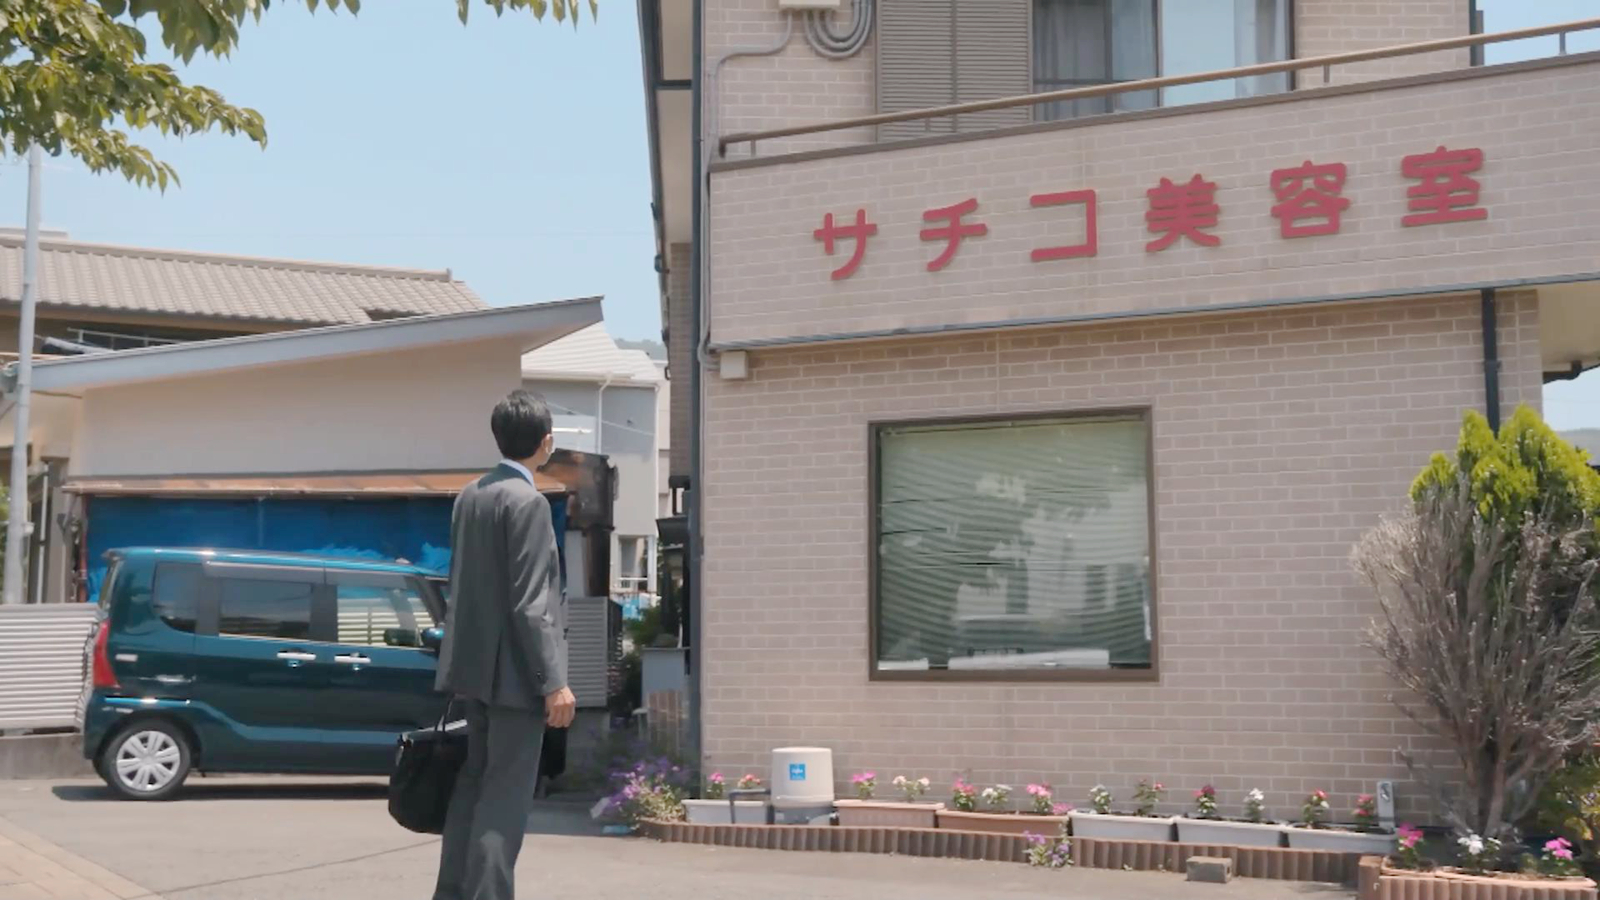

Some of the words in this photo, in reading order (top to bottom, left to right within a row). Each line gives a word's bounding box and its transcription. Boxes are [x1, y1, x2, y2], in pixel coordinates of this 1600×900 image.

[814, 145, 1488, 280] サチコ美容室
